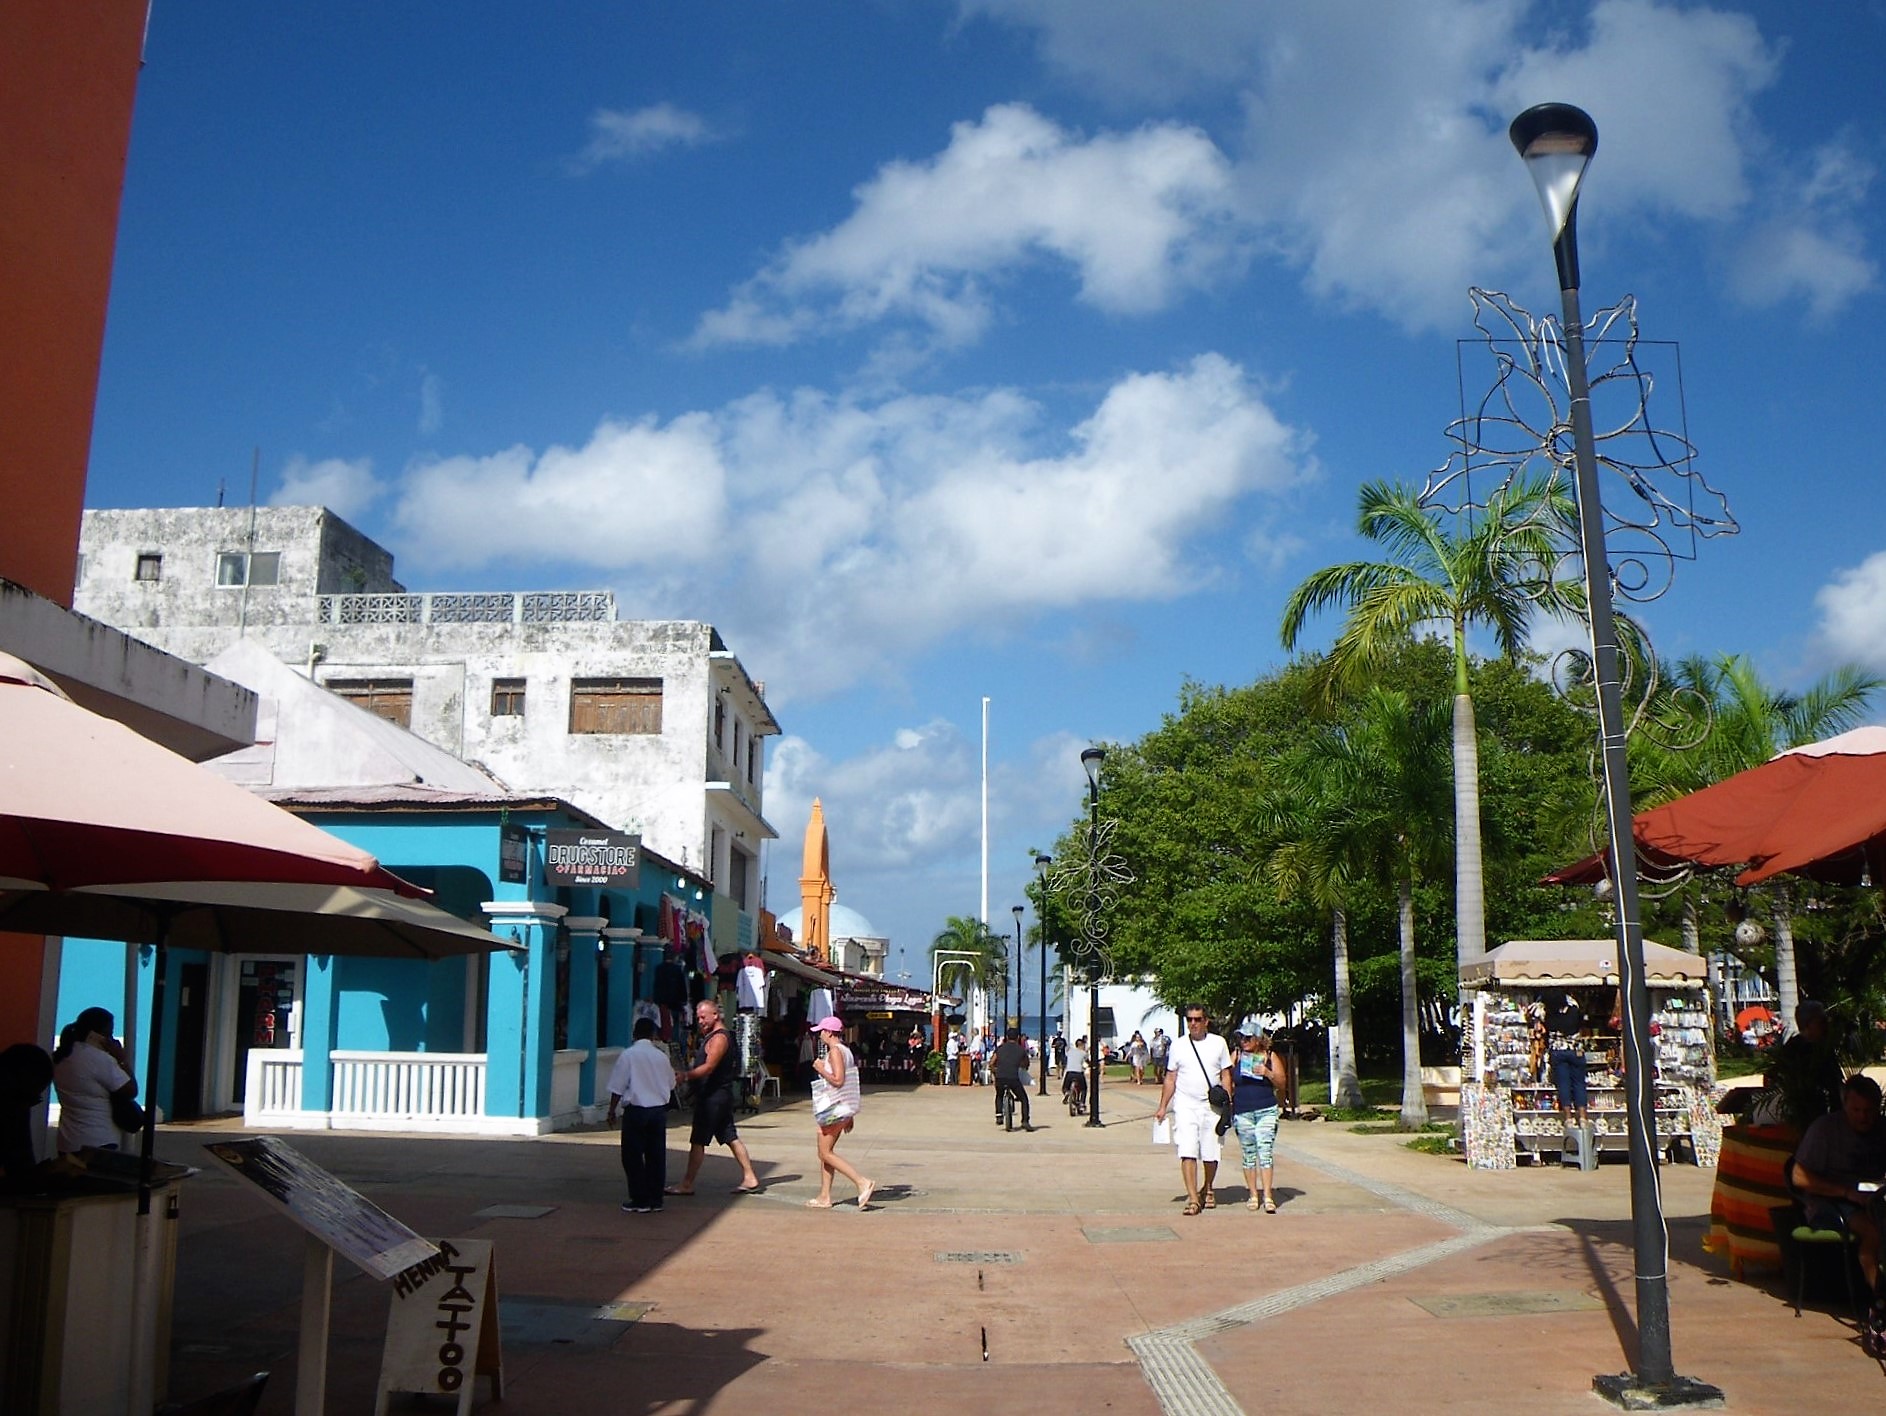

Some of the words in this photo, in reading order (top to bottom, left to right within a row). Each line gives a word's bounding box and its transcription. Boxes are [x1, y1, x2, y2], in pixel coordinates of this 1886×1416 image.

[549, 845, 636, 866] DRUGSTORE
[564, 865, 619, 875] FARMACIA
[575, 875, 591, 884] Since
[591, 875, 608, 884] 2000
[436, 1266, 476, 1391] TATTOO
